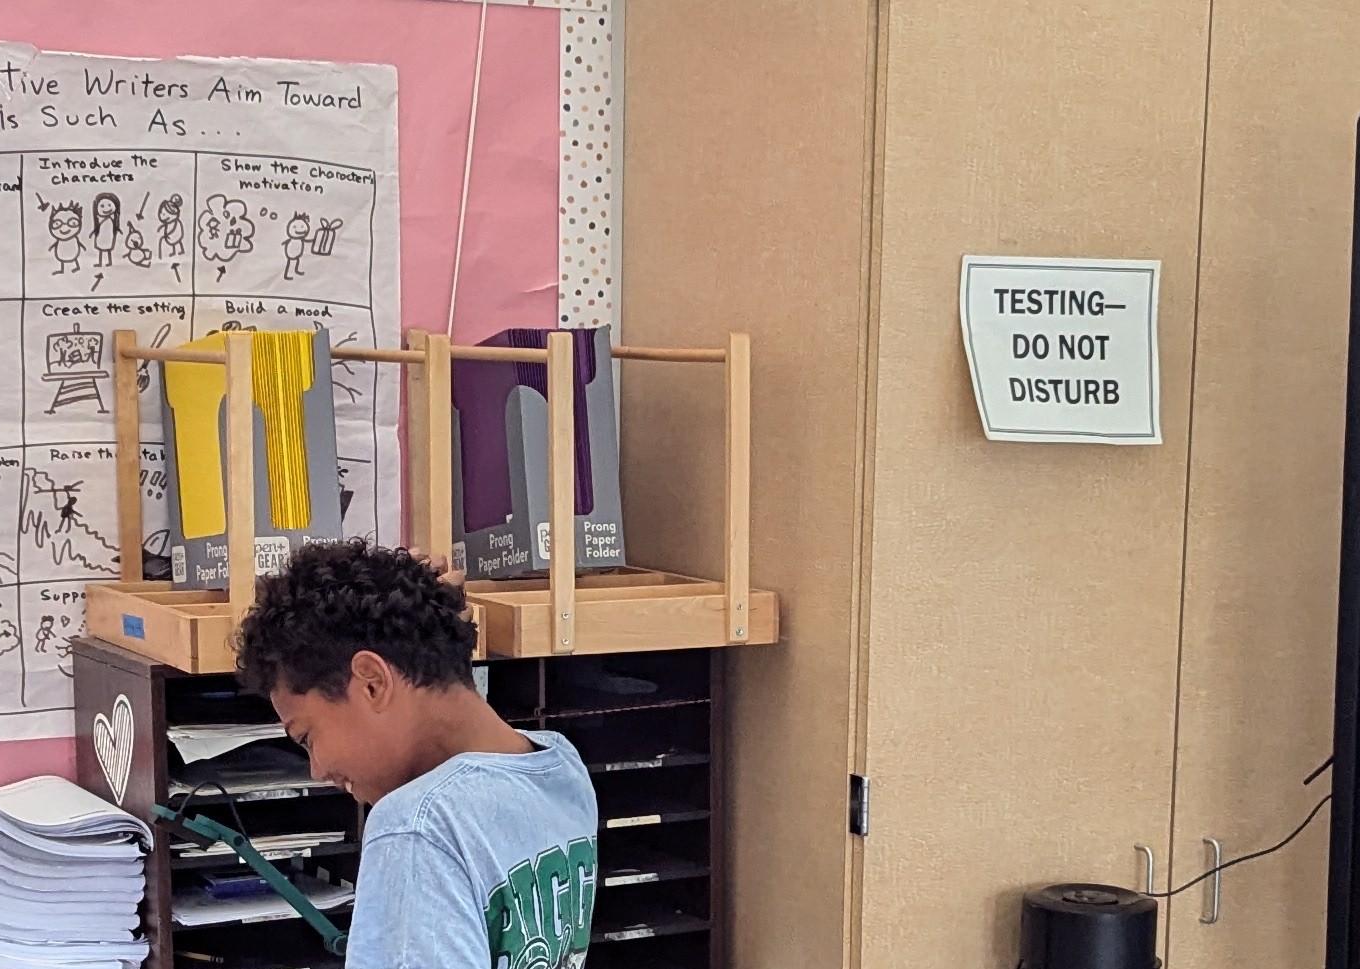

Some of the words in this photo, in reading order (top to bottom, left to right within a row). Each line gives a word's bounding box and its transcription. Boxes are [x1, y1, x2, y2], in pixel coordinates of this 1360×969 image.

[84, 69, 189, 100] Writers
[207, 77, 263, 104] Aim
[278, 80, 362, 110] Toward
[42, 106, 118, 128] Such
[39, 156, 123, 170] Introduce
[130, 154, 159, 169] the
[221, 159, 262, 174] Show
[270, 161, 299, 175] the
[51, 171, 135, 186] characters
[239, 178, 324, 194] motivation
[42, 304, 99, 318] Create
[106, 303, 130, 316] the
[138, 304, 186, 320] setting
[225, 301, 267, 315] Build
[277, 307, 288, 315] a
[295, 306, 333, 319] mood
[1013, 333, 1050, 360] DO
[1059, 335, 1109, 360] NOT
[1009, 377, 1120, 405] DISTURB
[50, 448, 91, 461] Raise
[97, 447, 117, 459] th
[584, 521, 616, 534] Prong
[490, 533, 514, 550] Prong
[585, 534, 616, 549] Paper
[206, 542, 228, 561] Prong
[586, 547, 620, 558] Folder
[478, 557, 500, 575] Paper
[502, 549, 529, 567] Folder
[196, 565, 216, 584] Paper
